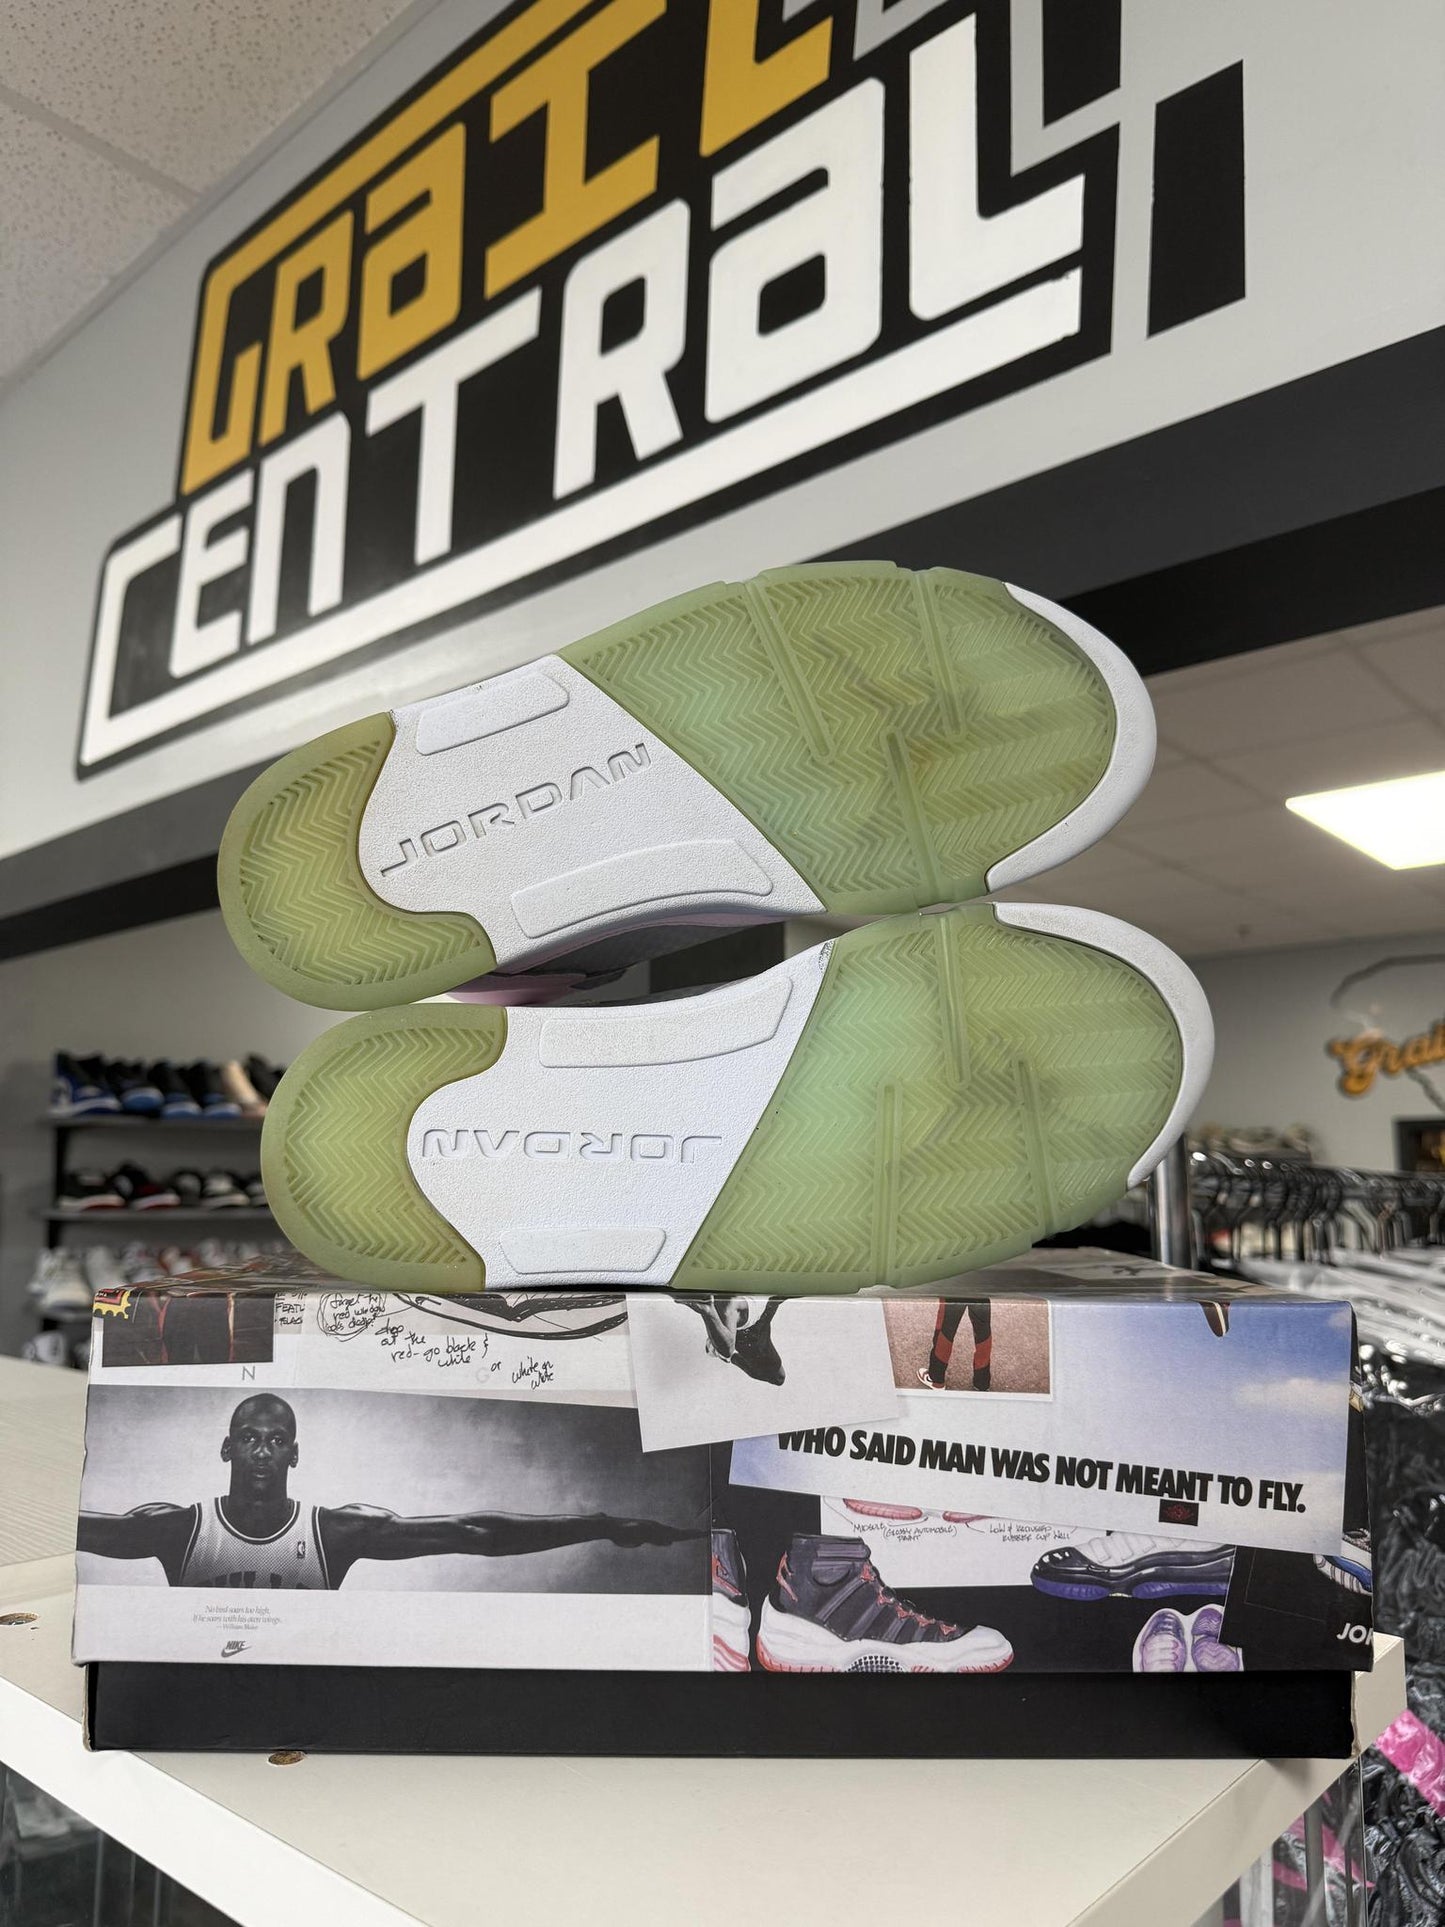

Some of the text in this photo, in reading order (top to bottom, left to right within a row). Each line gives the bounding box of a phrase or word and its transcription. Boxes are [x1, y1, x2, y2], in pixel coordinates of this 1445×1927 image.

[380, 742, 652, 877] JORDAN
[421, 1128, 723, 1164] JORDAN
[446, 1336, 477, 1354] black
[438, 1350, 471, 1367] white
[512, 1356, 539, 1384] white
[242, 1367, 256, 1381] N
[777, 1426, 1306, 1513] WHO SAID MAN WAS NOT MEANT TO FLY.
[226, 1640, 246, 1650] NIKE
